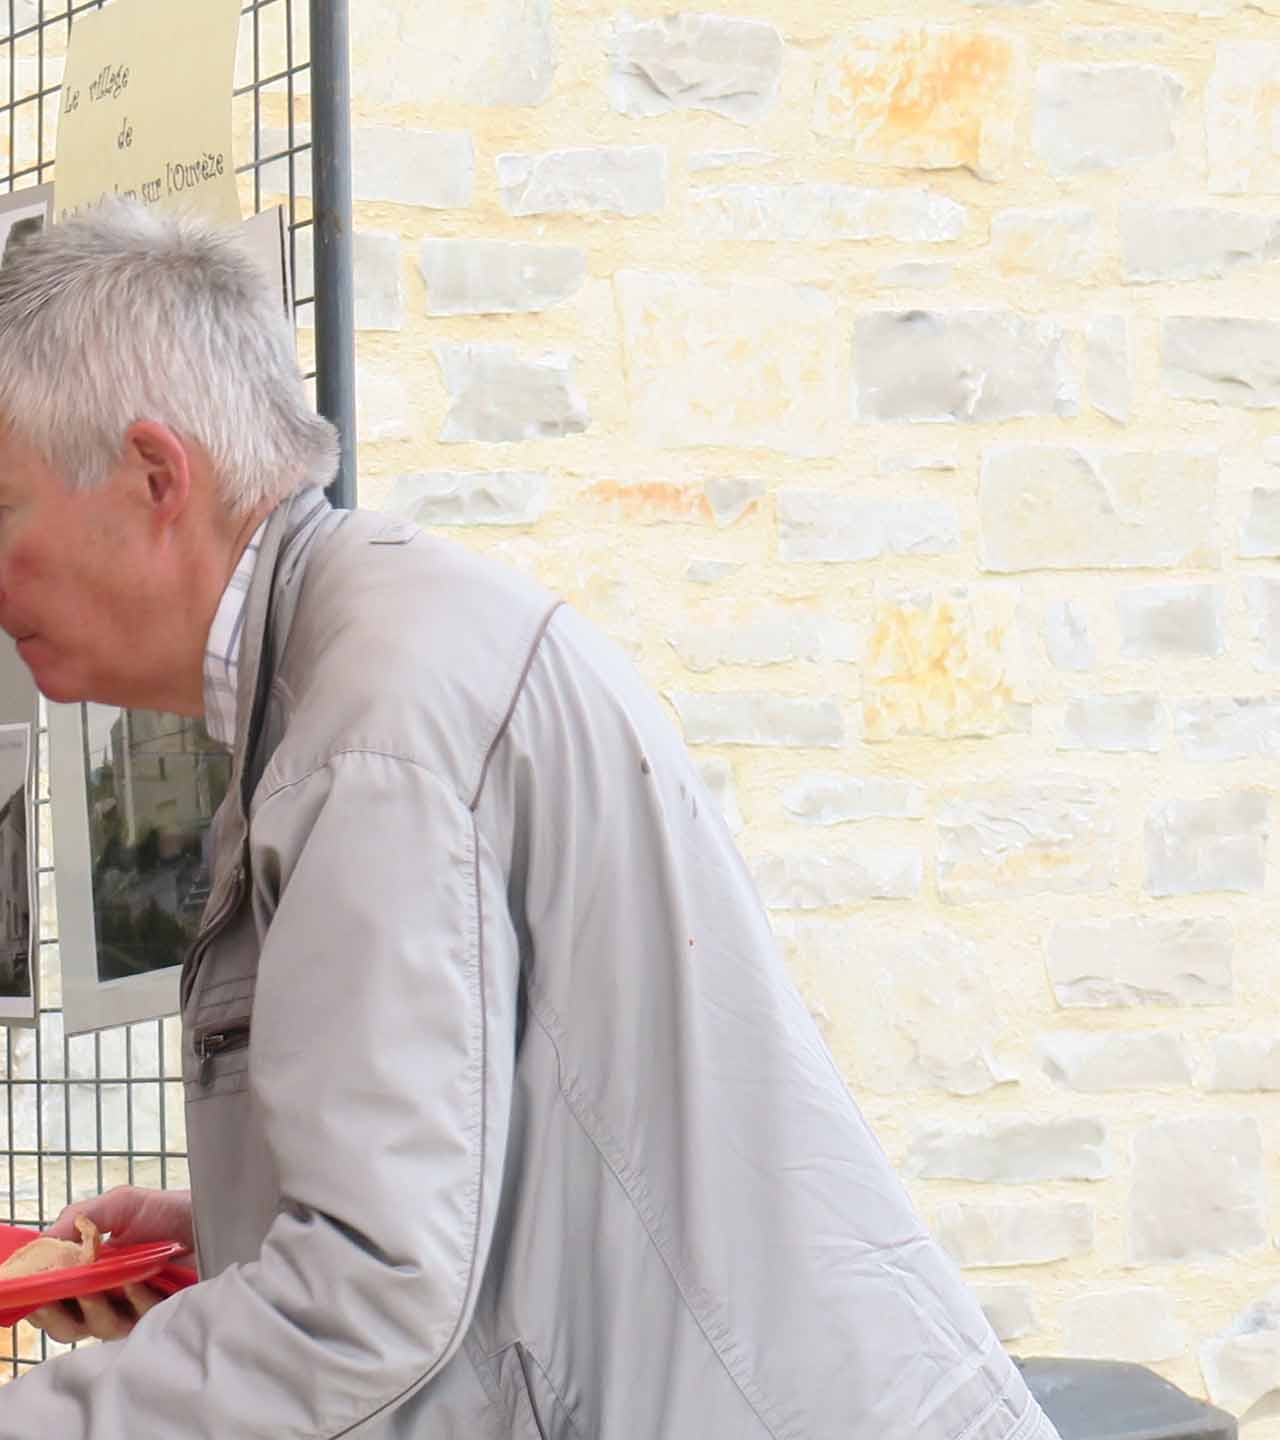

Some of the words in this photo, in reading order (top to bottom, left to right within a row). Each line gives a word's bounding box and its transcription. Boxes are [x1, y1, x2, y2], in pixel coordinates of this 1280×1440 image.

[64, 85, 80, 114] Le
[117, 117, 133, 150] de
[142, 177, 162, 207] sur
